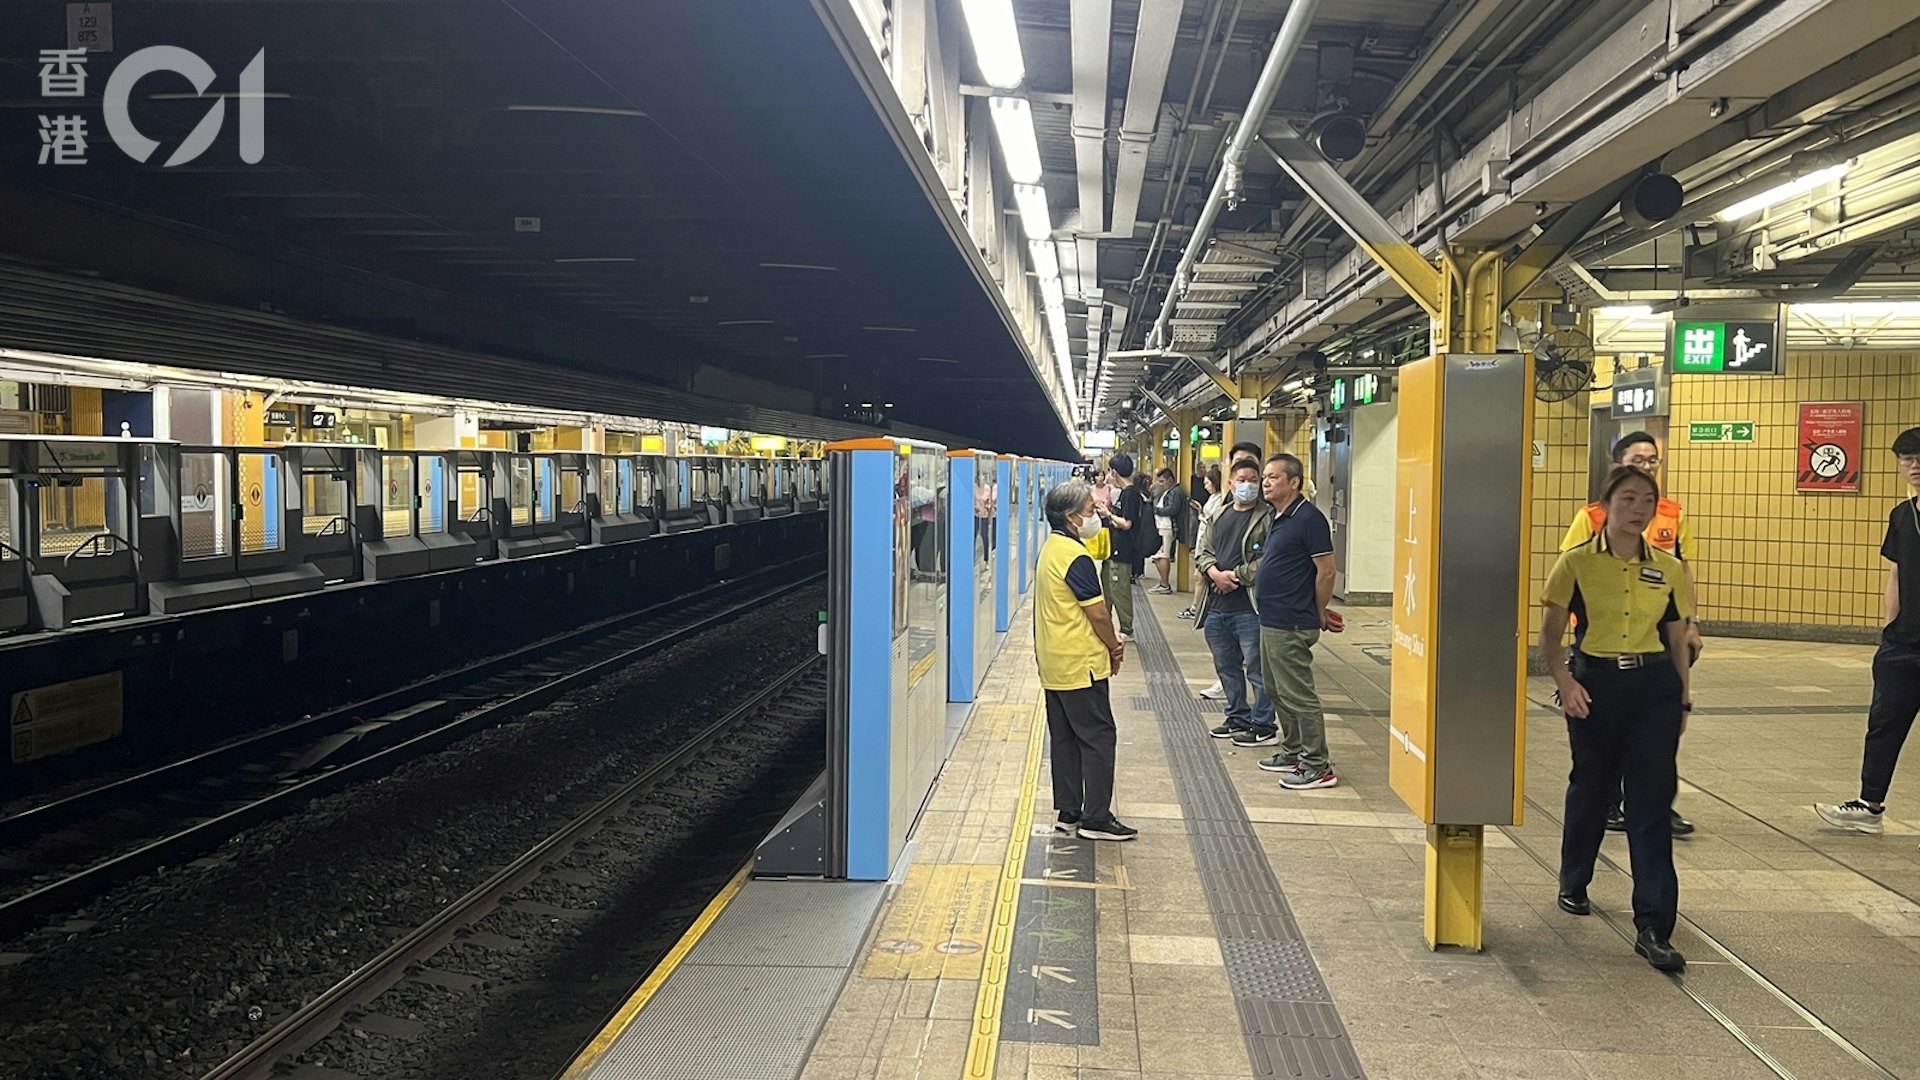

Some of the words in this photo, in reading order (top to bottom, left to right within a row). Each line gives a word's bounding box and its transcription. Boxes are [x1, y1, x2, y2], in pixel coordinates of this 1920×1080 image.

[79, 16, 97, 28] 129
[77, 30, 98, 42] 875
[1684, 329, 1715, 354] 出
[1683, 354, 1713, 365] EXIT
[1404, 488, 1418, 617] 上水
[1394, 624, 1411, 656] Sheung
[1412, 633, 1424, 657] Shui
